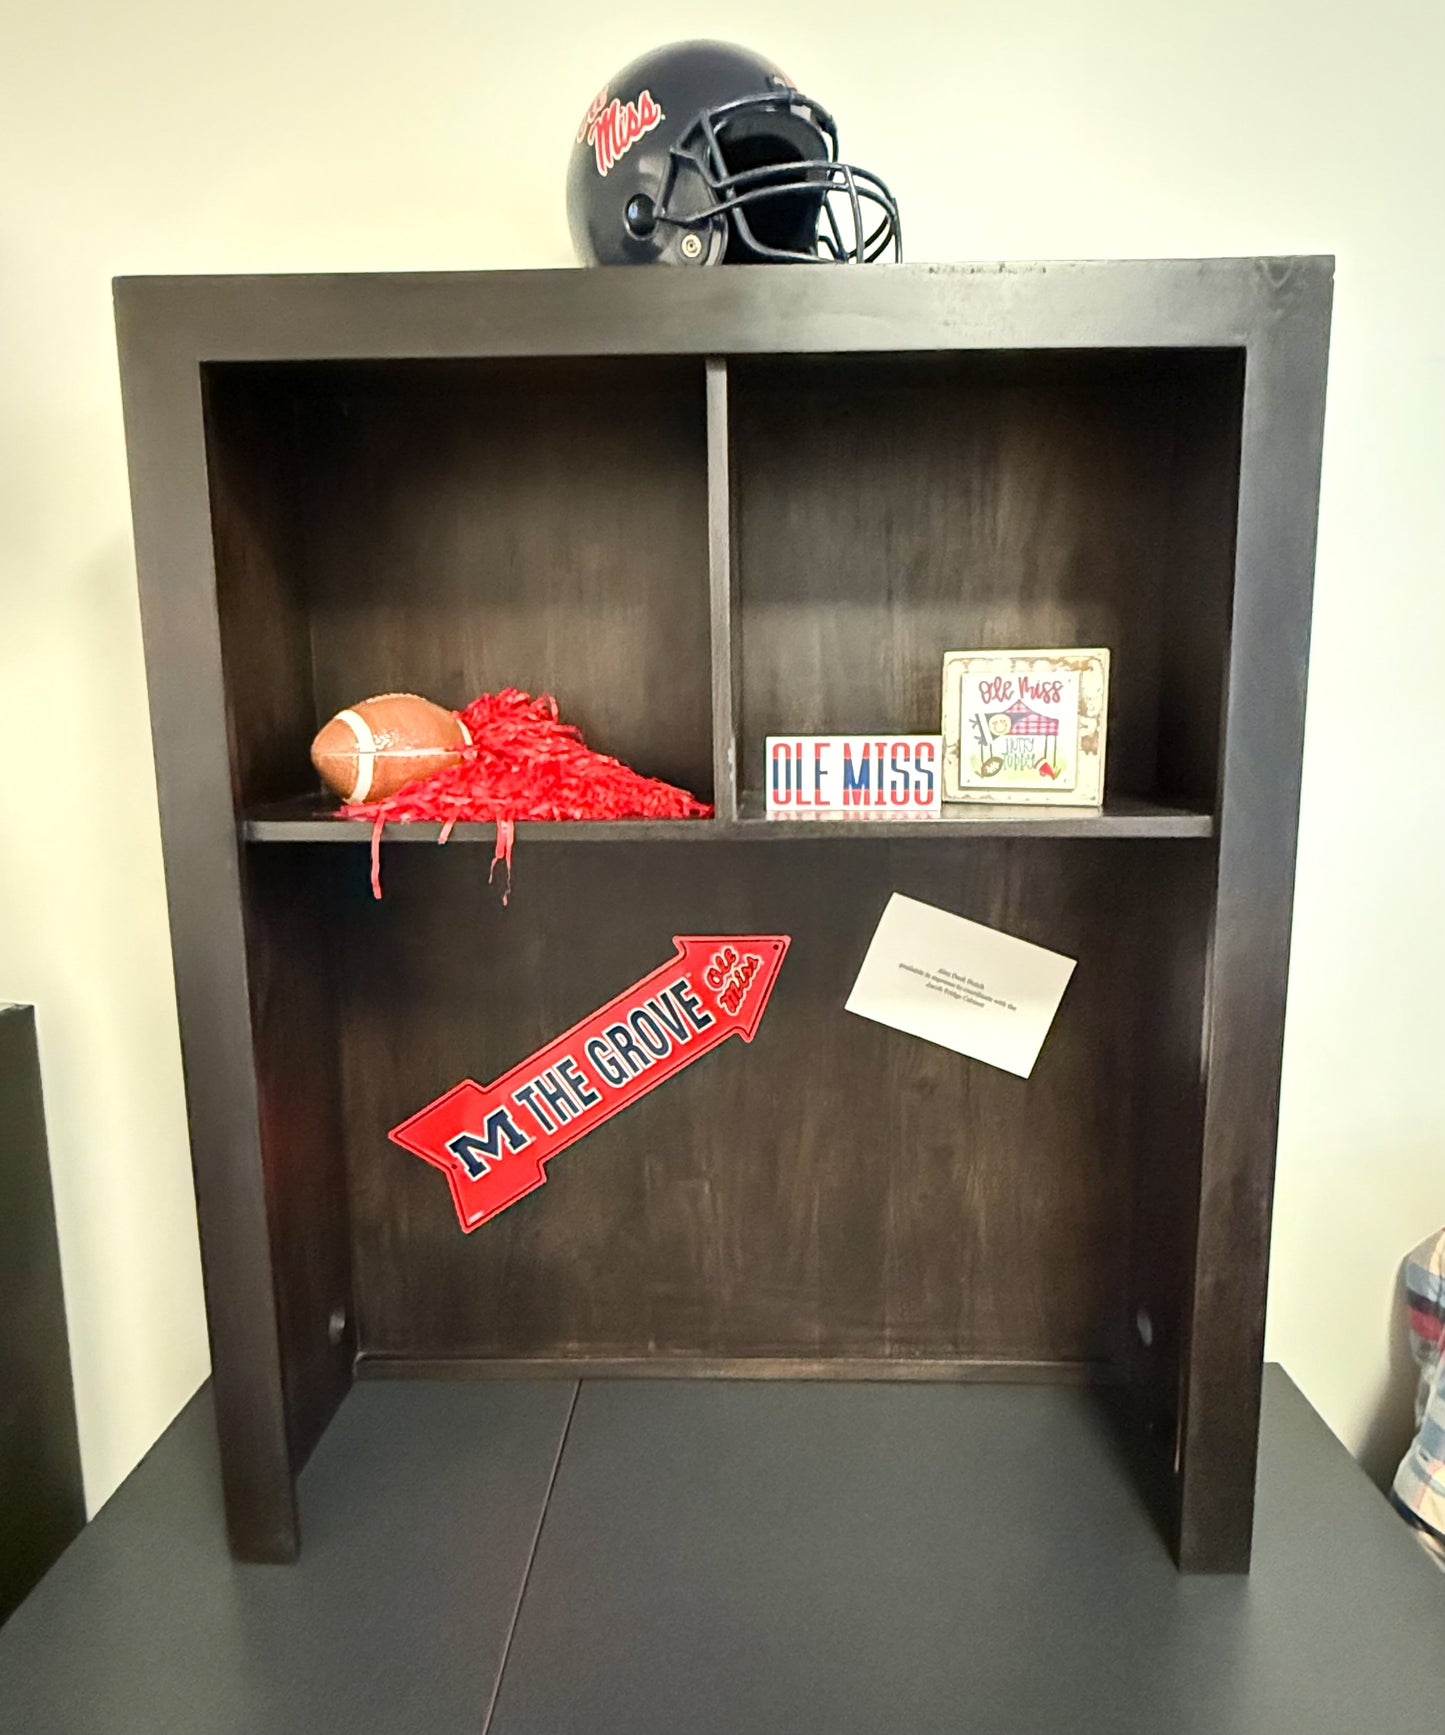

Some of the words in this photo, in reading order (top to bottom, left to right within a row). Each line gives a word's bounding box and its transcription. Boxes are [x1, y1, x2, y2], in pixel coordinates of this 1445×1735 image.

[588, 90, 661, 177] Miss
[979, 676, 1014, 704] Ole
[1018, 676, 1063, 704] Miss
[772, 742, 830, 805] OLE
[843, 742, 935, 806] MISS
[705, 946, 738, 990] Ole
[717, 954, 761, 1016] Miss
[446, 1106, 531, 1182] M
[513, 1055, 603, 1135] THE
[586, 977, 714, 1088] GROVE
